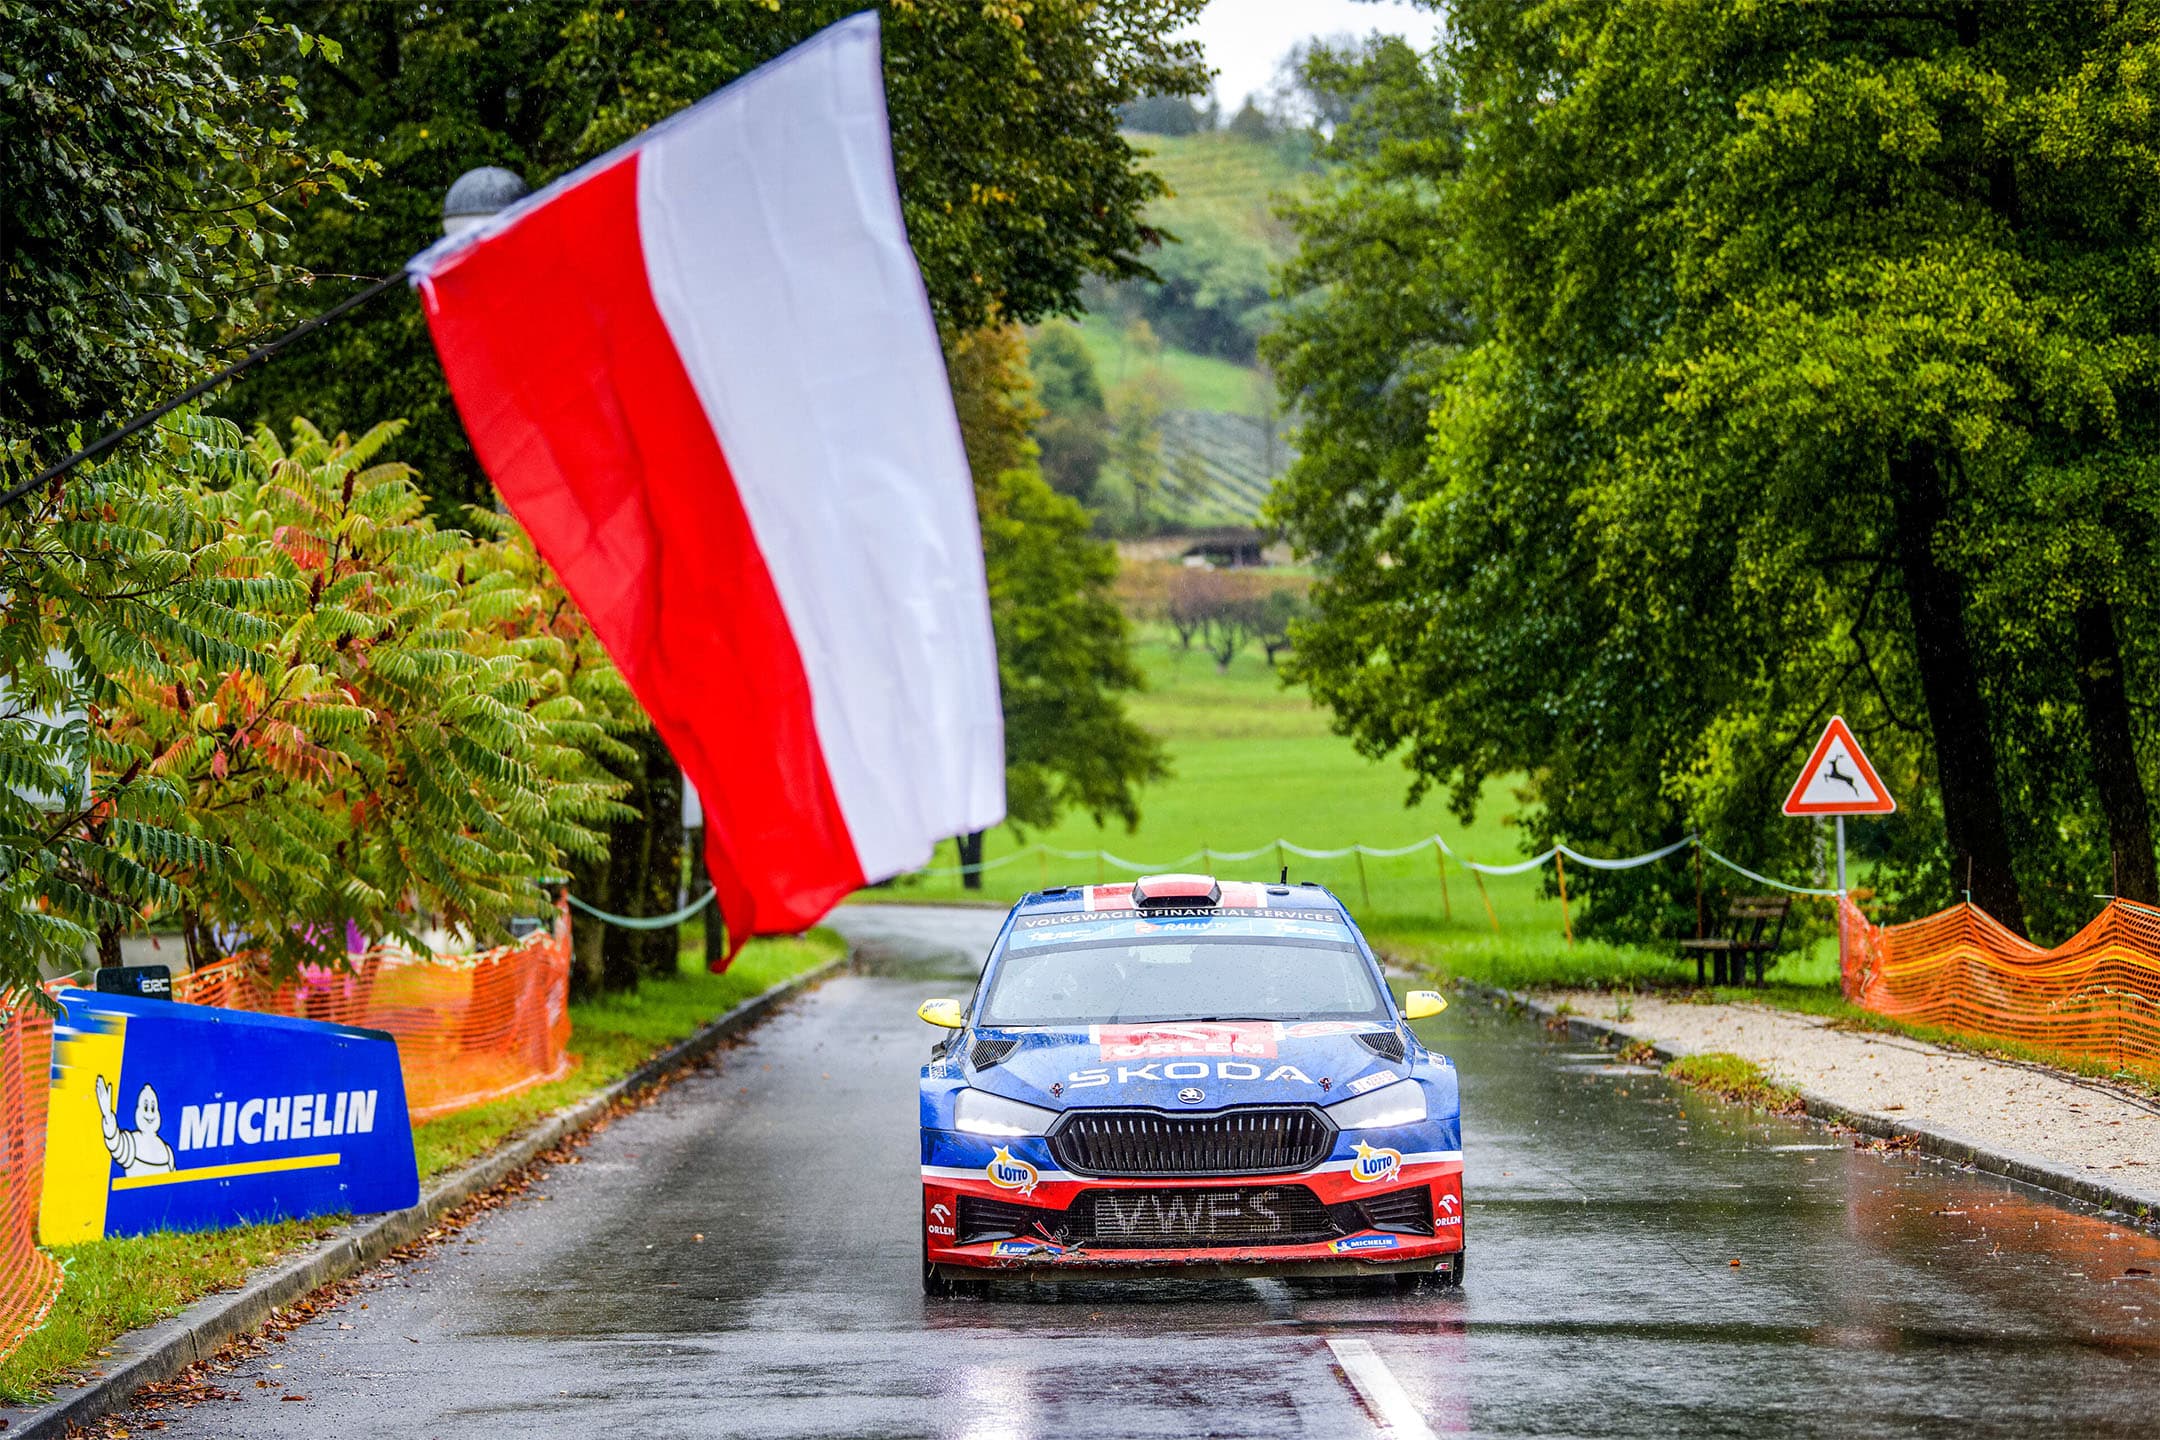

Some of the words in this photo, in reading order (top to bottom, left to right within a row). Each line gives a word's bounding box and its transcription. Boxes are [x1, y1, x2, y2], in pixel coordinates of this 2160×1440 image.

[1025, 909, 1148, 928] VOLKSWAGEN
[1155, 908, 1249, 917] FINANCIAL
[1252, 909, 1335, 922] SERVICES
[1164, 922, 1210, 931] RALLY
[1111, 1042, 1265, 1057] ORLEN
[178, 1089, 378, 1151] MICHELIN
[1363, 1155, 1392, 1174] LOTTO
[998, 1164, 1028, 1182] LOTTO
[1108, 1192, 1281, 1234] VWFS
[1435, 1215, 1461, 1227] ORLEN
[928, 1225, 955, 1236] ORLEN
[1350, 1239, 1393, 1248] MICHELIN
